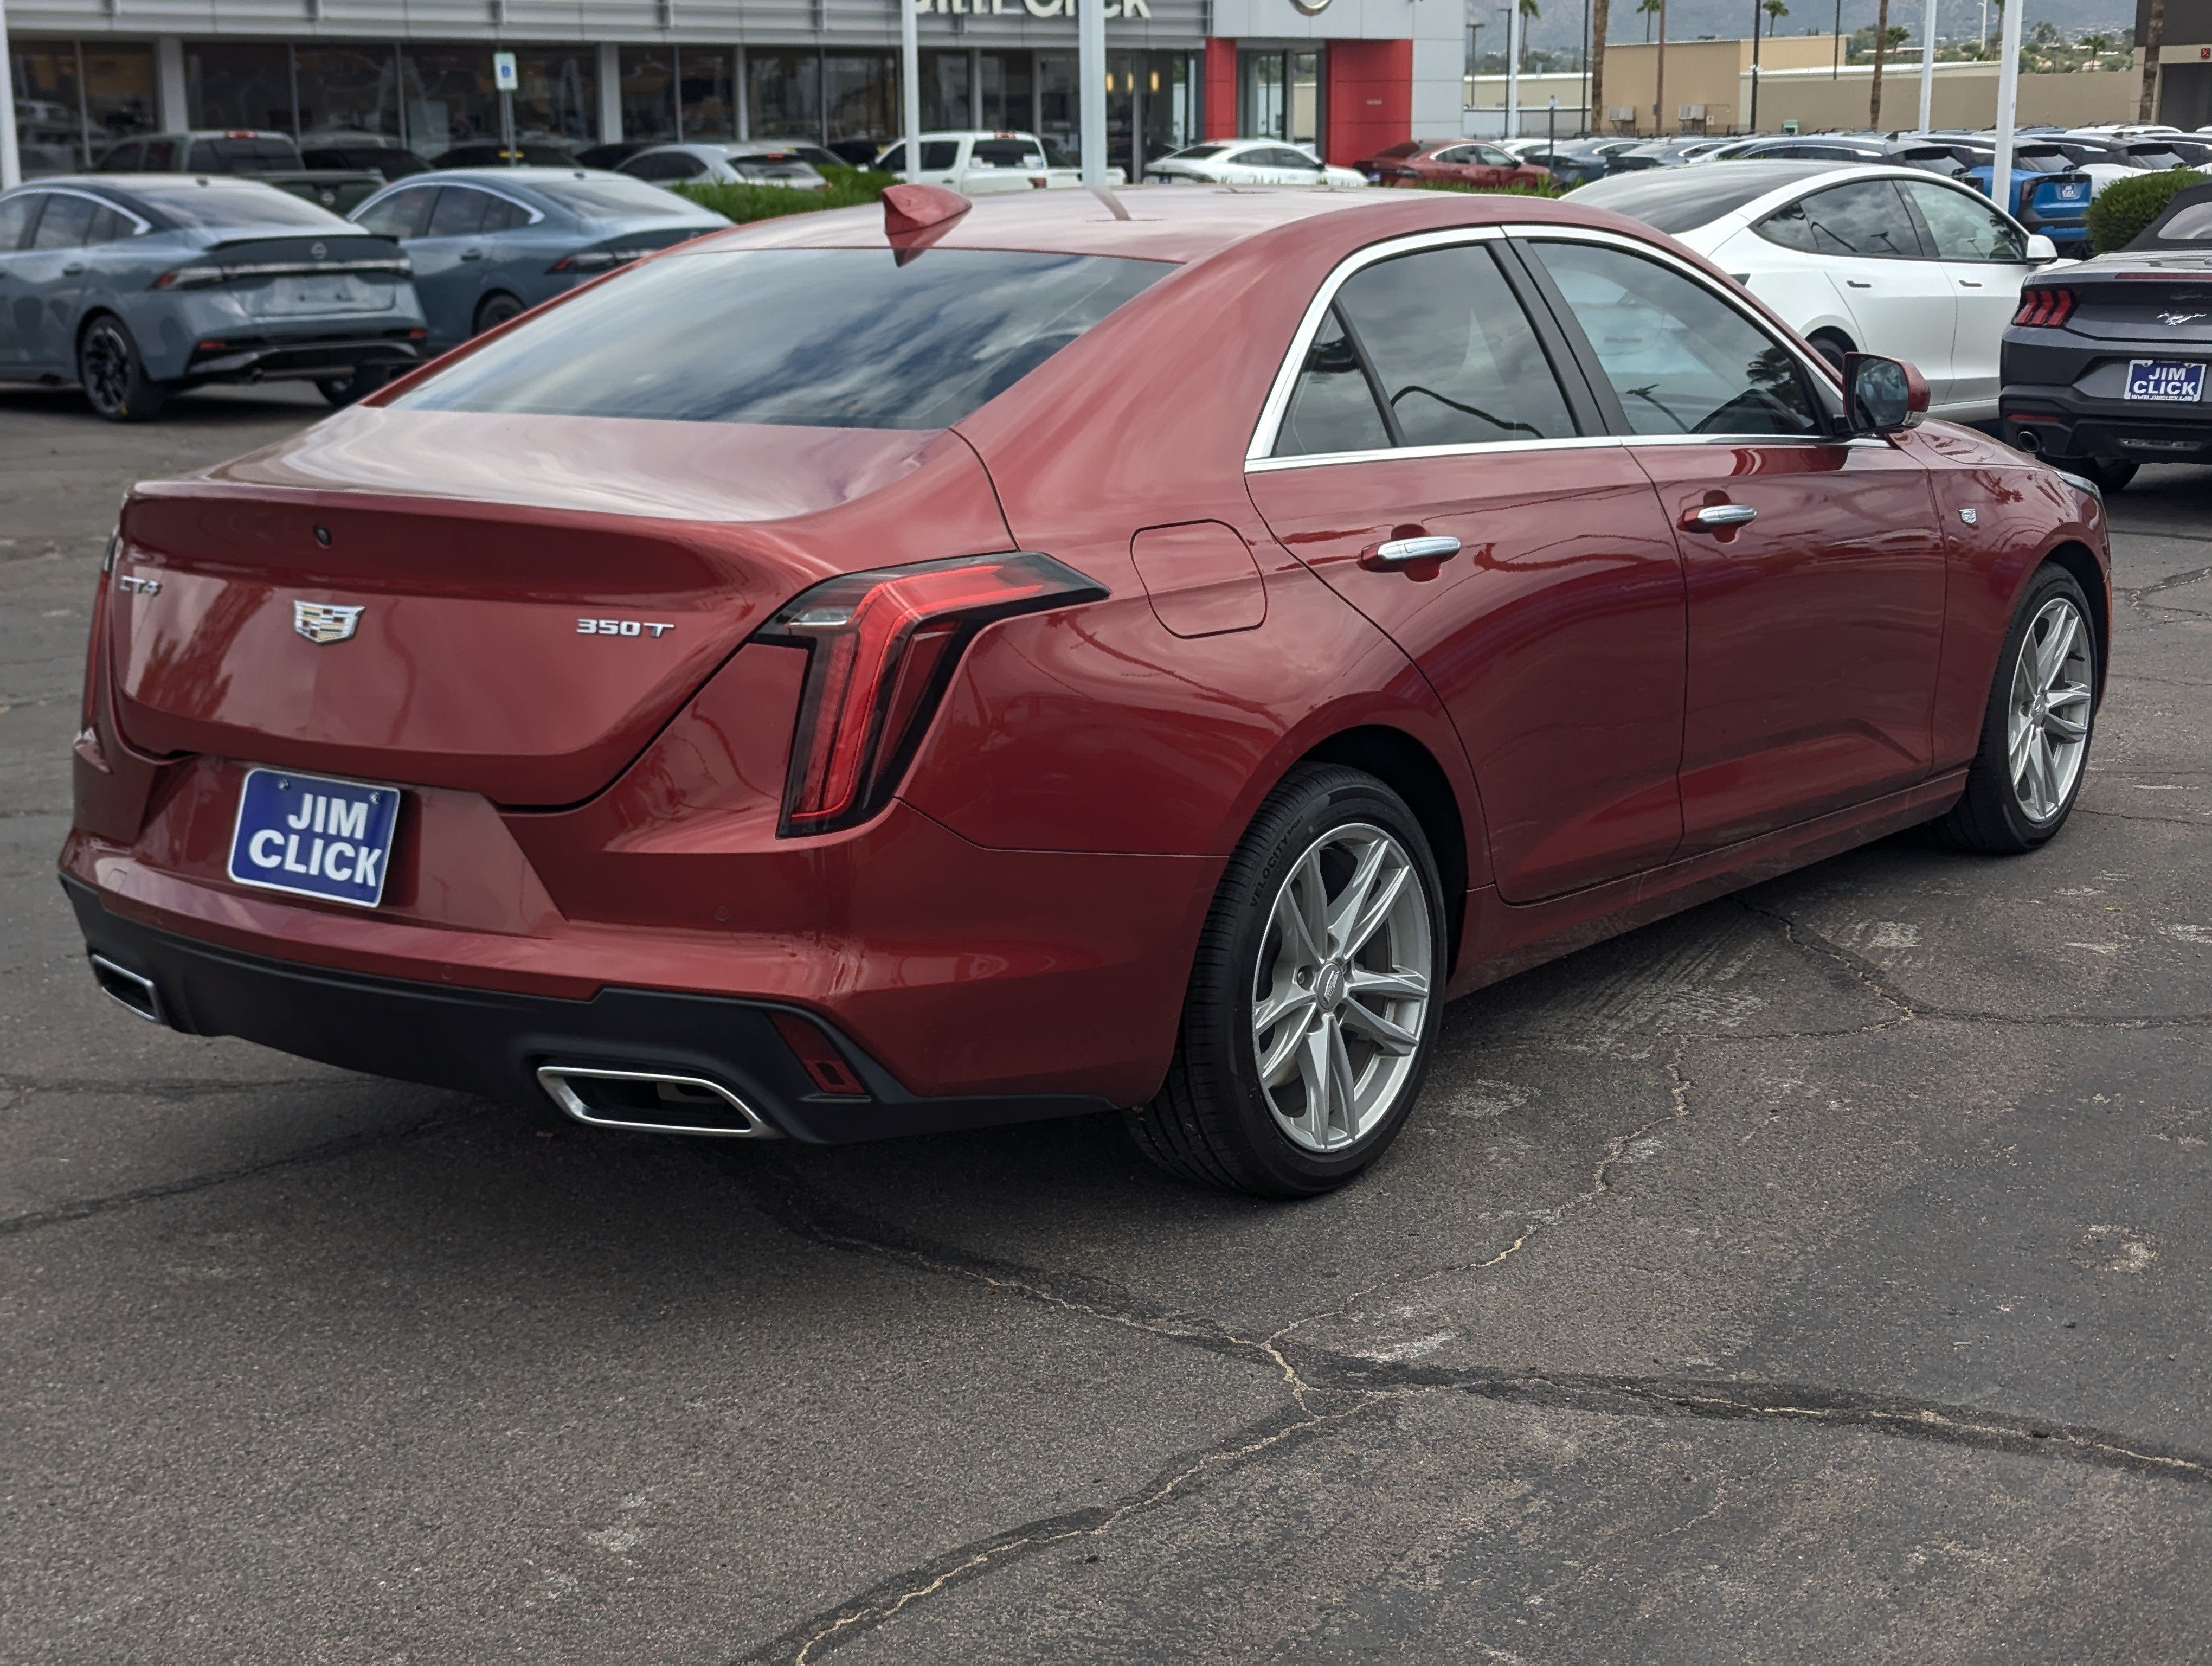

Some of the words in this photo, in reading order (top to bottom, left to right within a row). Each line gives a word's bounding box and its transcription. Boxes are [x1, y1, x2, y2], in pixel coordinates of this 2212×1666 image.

[2133, 380, 2196, 395] CLICK
[2148, 367, 2187, 381] JIM
[120, 575, 162, 596] CT4
[287, 793, 369, 840] JIM
[248, 829, 383, 887] CLICK
[1249, 835, 1289, 907] VELOCITY
